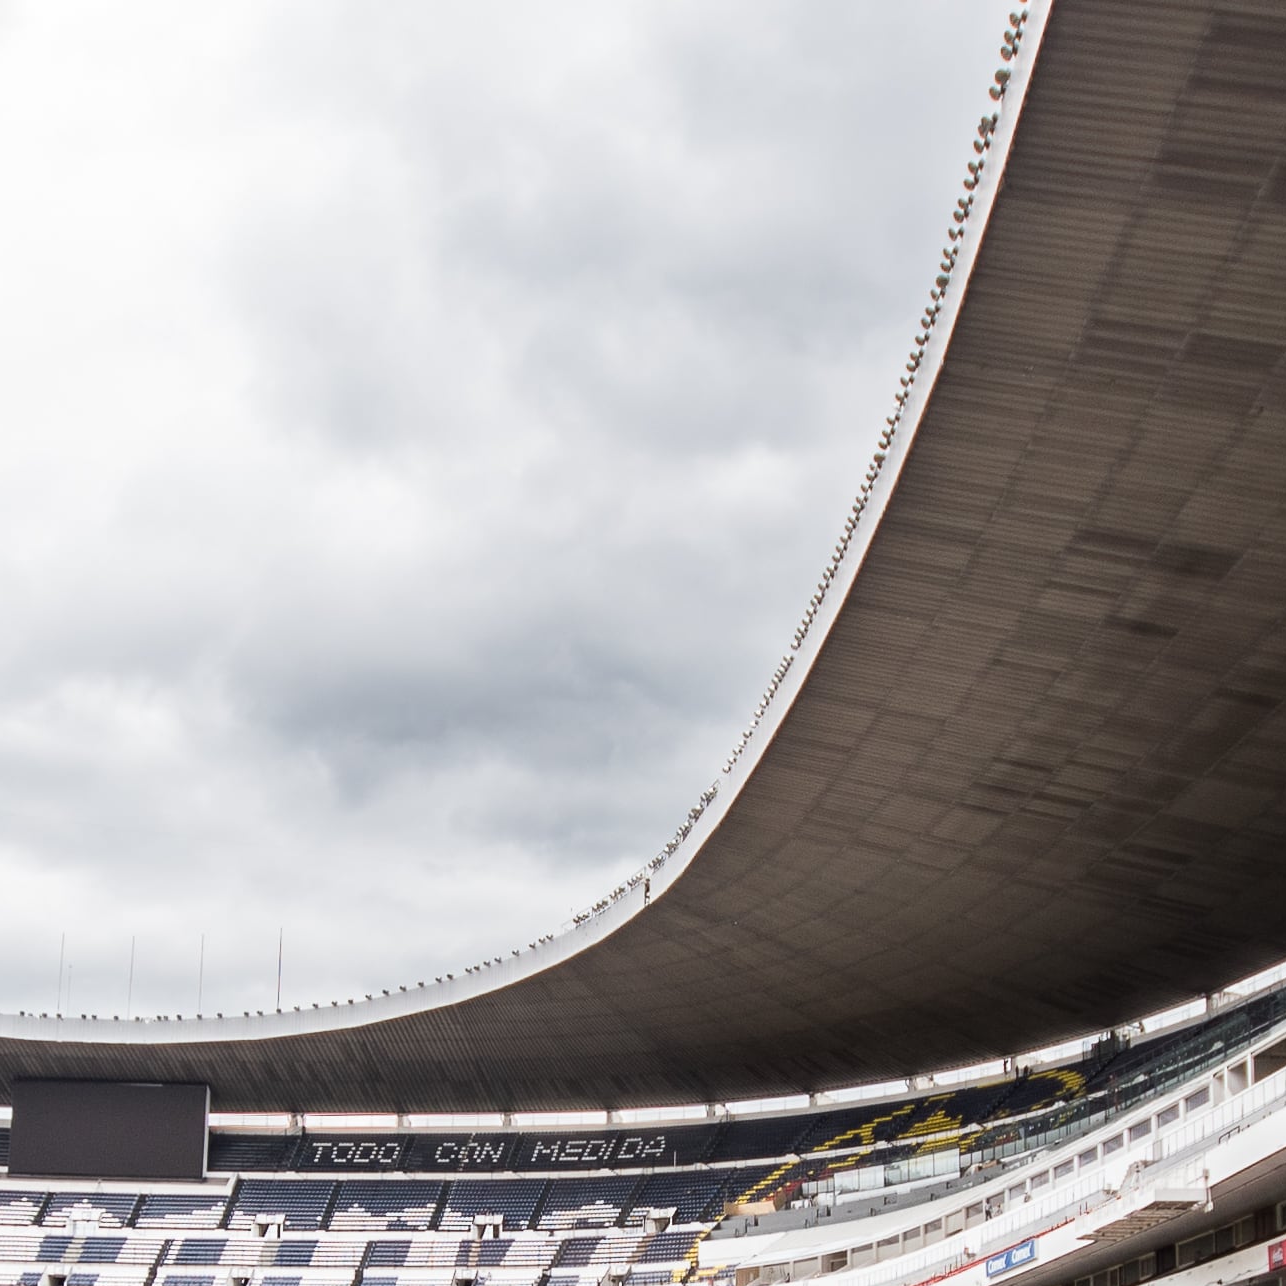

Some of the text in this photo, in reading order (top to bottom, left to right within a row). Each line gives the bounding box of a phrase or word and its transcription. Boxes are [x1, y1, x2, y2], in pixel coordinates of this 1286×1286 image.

[312, 1136, 666, 1163] TODO CON MEDIDA
